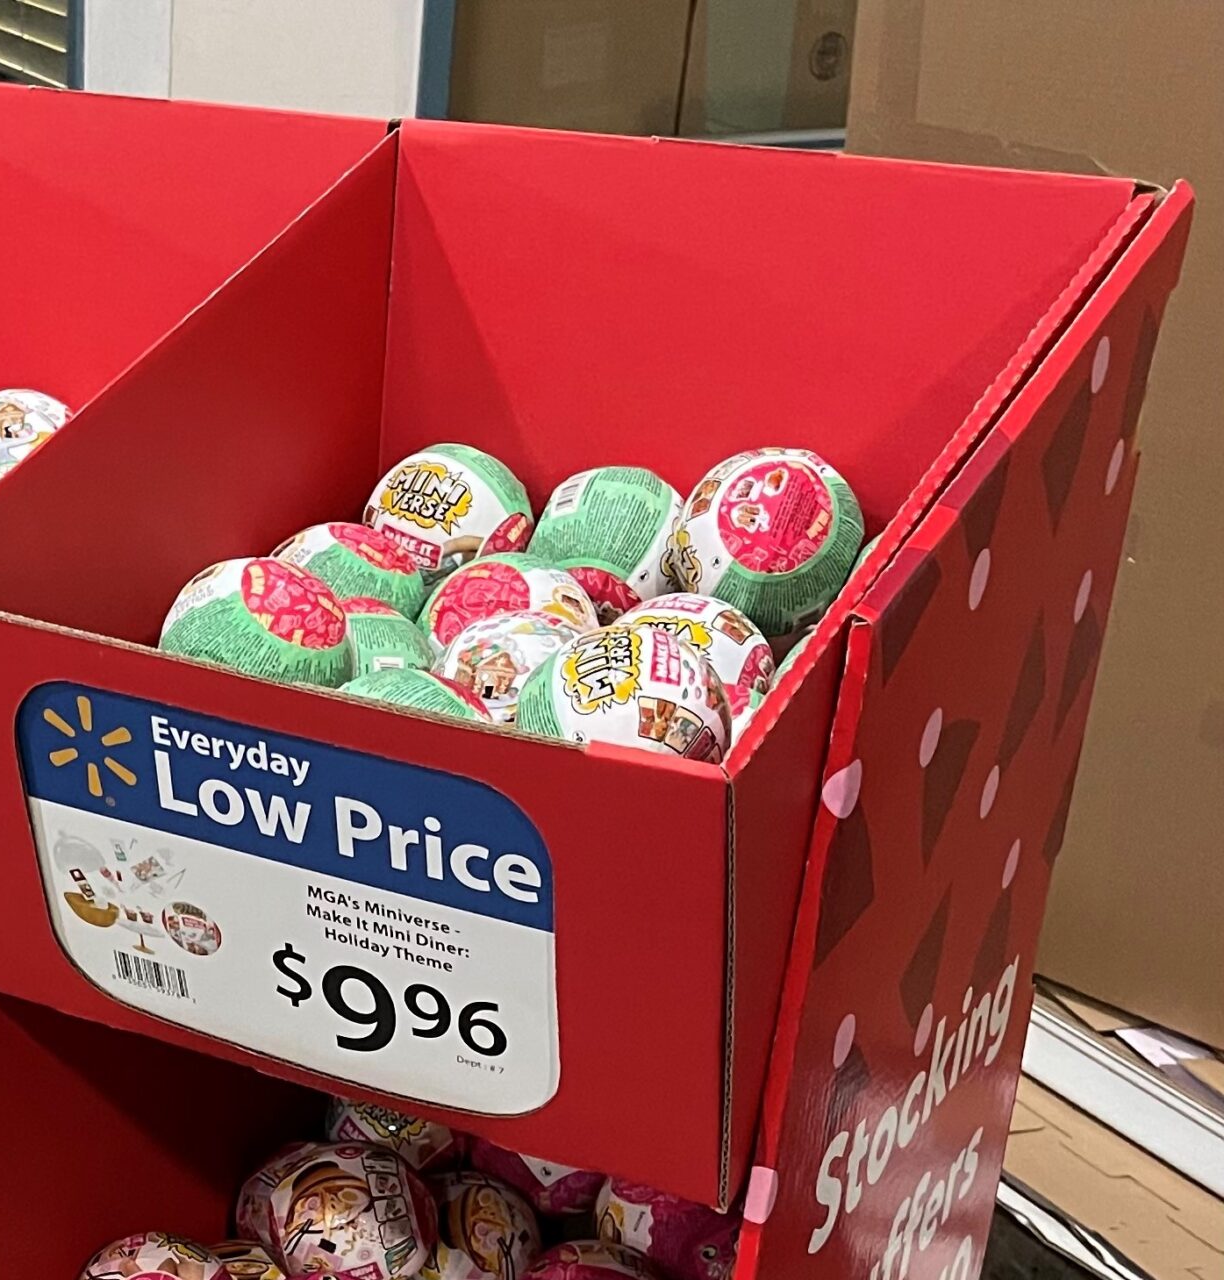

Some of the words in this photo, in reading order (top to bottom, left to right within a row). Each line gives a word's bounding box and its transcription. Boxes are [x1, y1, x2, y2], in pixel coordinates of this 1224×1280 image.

[387, 468, 468, 506] MINI
[390, 490, 452, 522] VERSE
[420, 543, 435, 556] IT
[151, 715, 310, 787] Everyday
[155, 750, 312, 844] Low
[335, 797, 542, 903] Price
[307, 904, 351, 926] Make
[357, 917, 369, 931] It
[374, 922, 411, 942] Mini
[416, 934, 470, 958] Diner:
[308, 885, 360, 910] MGA's
[365, 901, 450, 933] Miniverse
[325, 928, 390, 958] Holiday
[393, 946, 453, 972] Theme
[808, 954, 1019, 1254] Stocking
